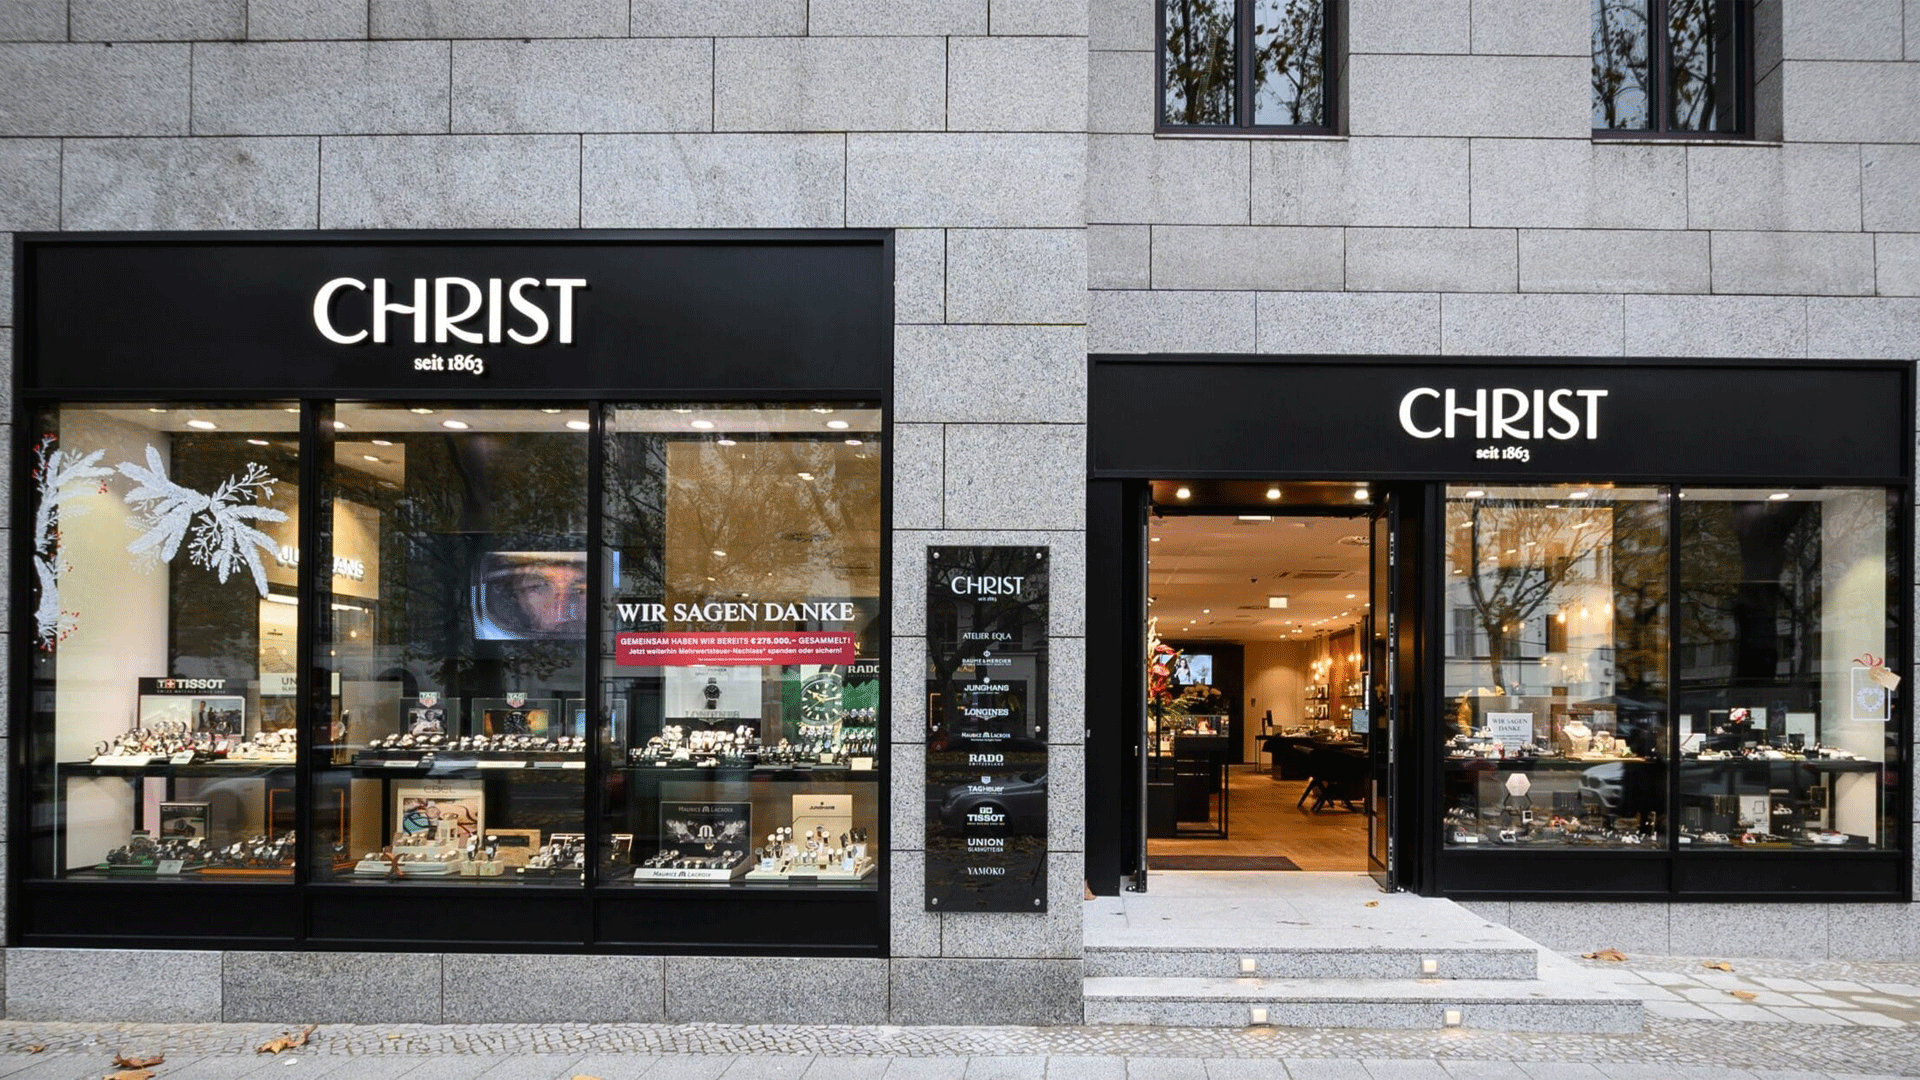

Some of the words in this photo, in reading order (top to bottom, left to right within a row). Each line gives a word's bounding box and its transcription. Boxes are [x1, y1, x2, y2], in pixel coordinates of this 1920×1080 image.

[313, 277, 587, 344] CHRIST
[414, 354, 444, 370] seit
[449, 354, 484, 375] 1863
[1399, 387, 1608, 440] CHRIST
[1476, 446, 1500, 459] seit
[1502, 446, 1530, 462] 1863
[951, 576, 1025, 595] CHRIST
[616, 603, 668, 622] WIR
[673, 603, 758, 622] SAGEN
[764, 602, 855, 622] DANKE
[620, 637, 669, 646] GEMEINSAM
[671, 637, 699, 646] HABEN
[700, 637, 716, 646] WIR
[717, 637, 749, 646] BEREITS
[798, 637, 851, 645] GESAMMELT!
[962, 632, 990, 640] ATELIER
[992, 632, 1012, 641] EQLA
[767, 647, 797, 655] spenden
[797, 647, 814, 655] oder
[815, 647, 843, 655] sichern!
[176, 679, 226, 689] TISSOT
[964, 708, 1010, 716] LONGINES
[969, 754, 1004, 762] RADO
[968, 838, 1004, 846] UNION
